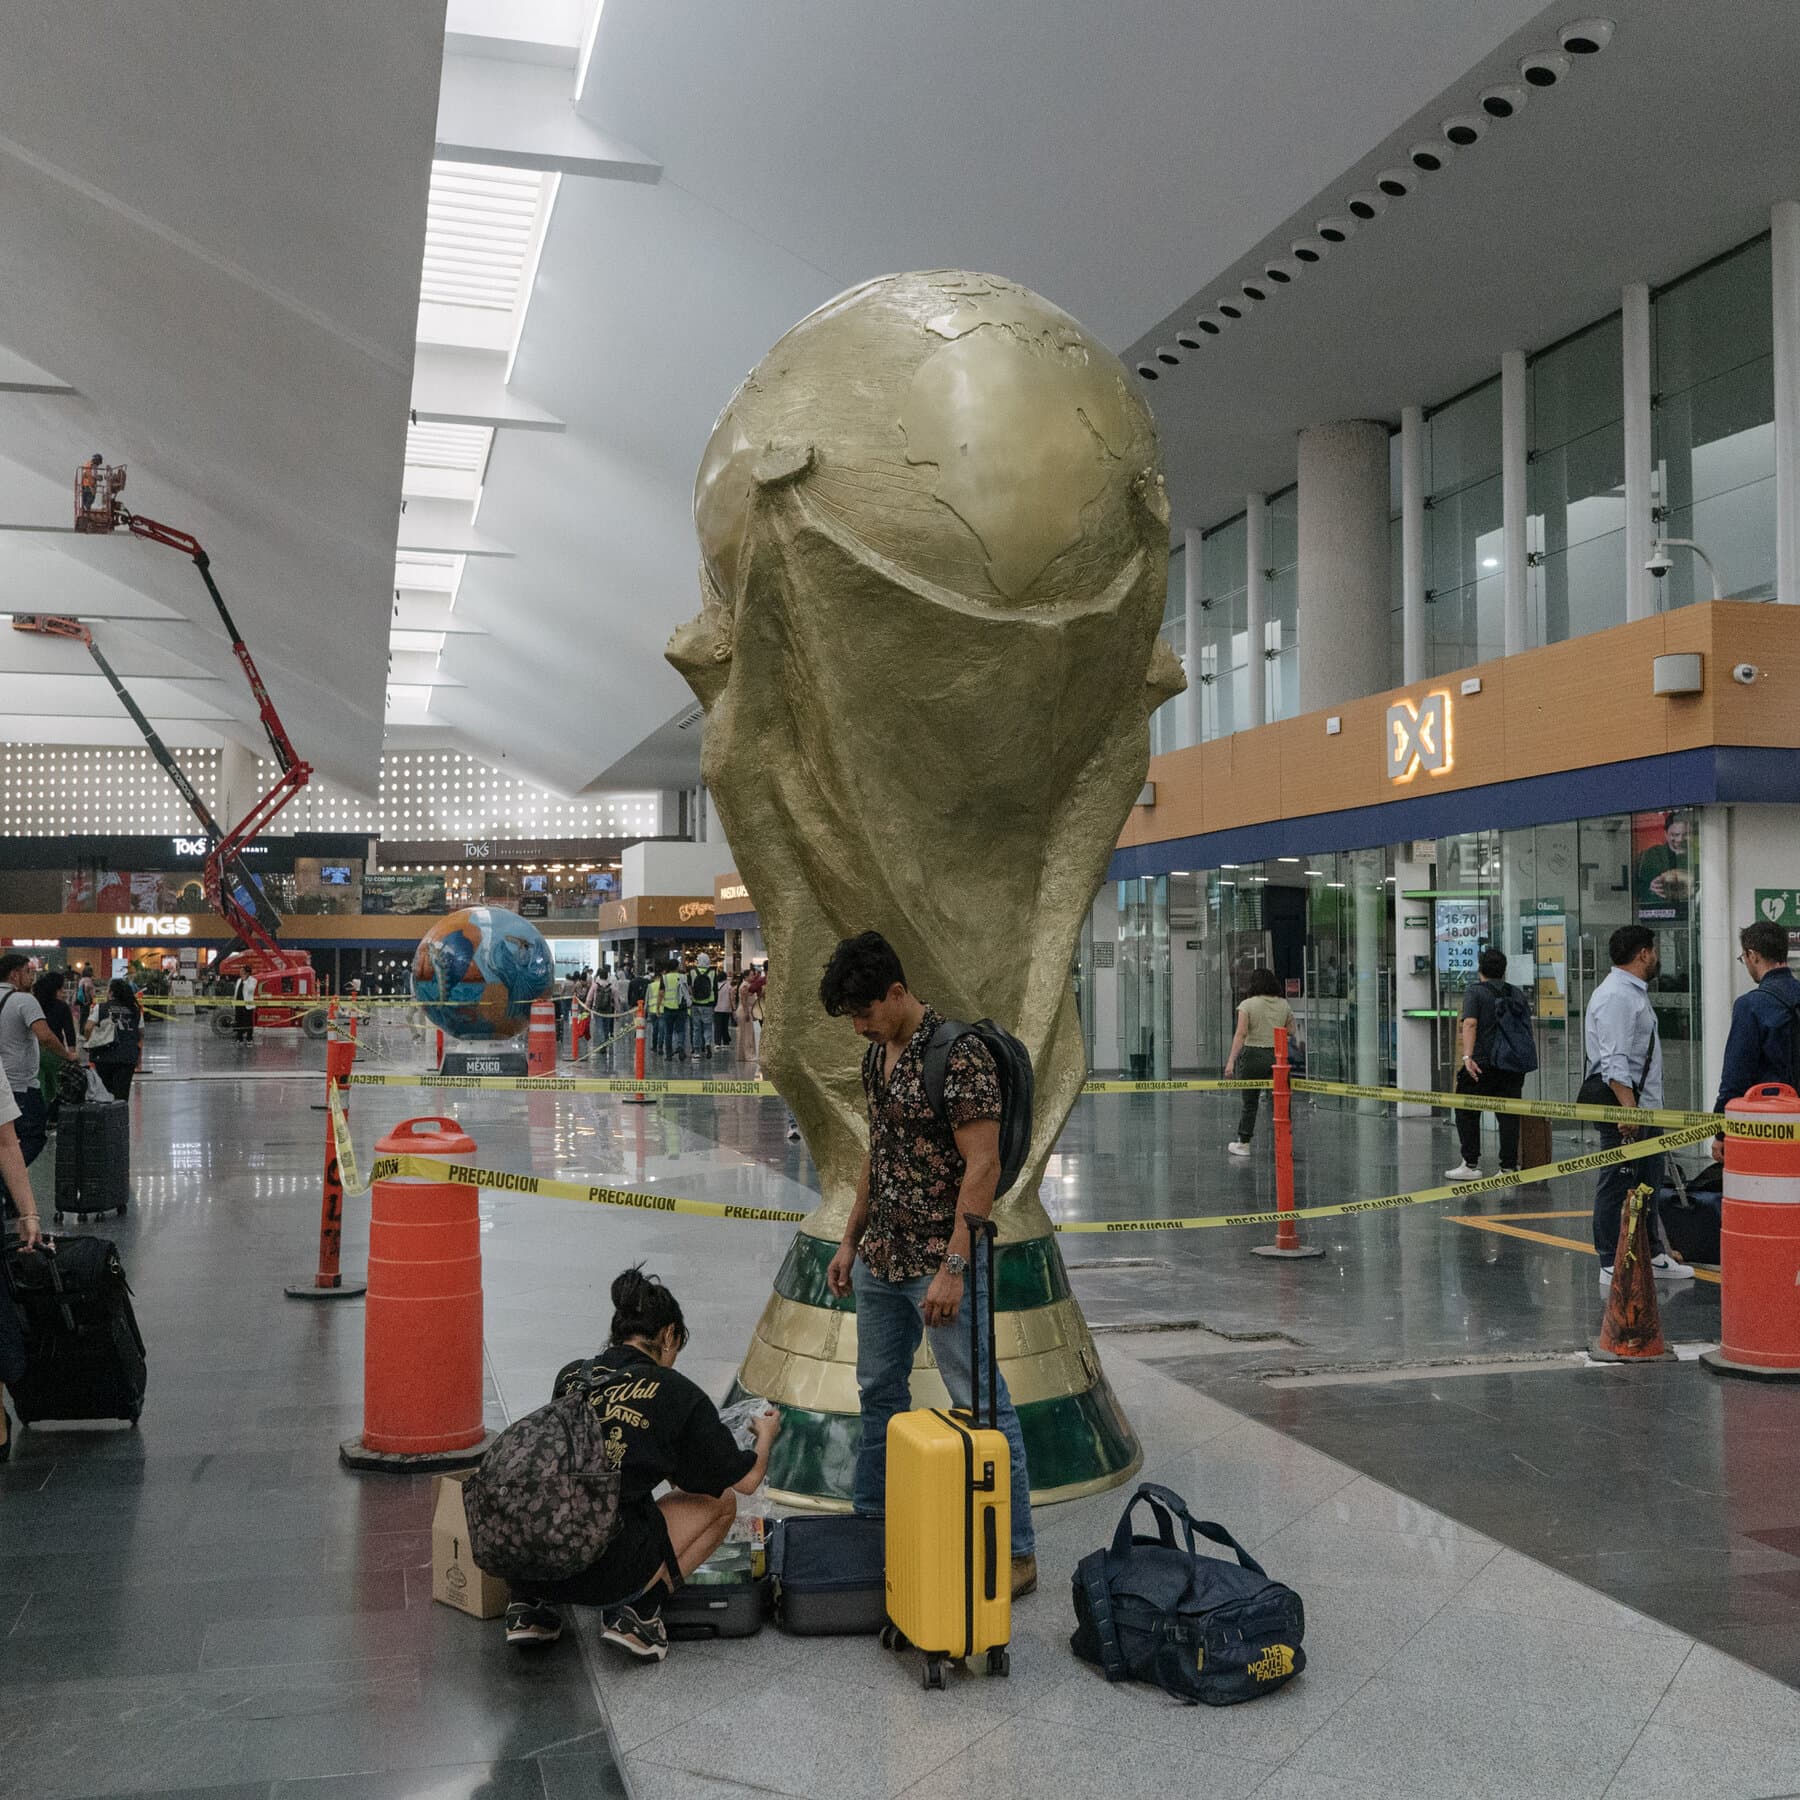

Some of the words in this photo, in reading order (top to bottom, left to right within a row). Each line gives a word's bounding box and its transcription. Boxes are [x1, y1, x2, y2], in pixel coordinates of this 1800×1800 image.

[116, 916, 191, 935] WINGS
[1445, 913, 1477, 924] 16.70
[1445, 927, 1477, 937] 18.00
[1448, 948, 1473, 956] 21.40
[466, 1060, 500, 1074] MÉXICO
[1726, 1121, 1794, 1139] PRECAUCION
[1451, 1173, 1522, 1196] PRECAUCION
[1557, 1149, 1627, 1174] PRECAUCION
[1658, 1121, 1723, 1148] PRECAUCION
[448, 1164, 539, 1193] PRECAUCION
[589, 1187, 676, 1211] PRECAUCION
[604, 1378, 661, 1403] Wall
[1261, 1644, 1281, 1660] THE
[1247, 1656, 1282, 1676] NORTH
[1256, 1667, 1283, 1682] FACE
